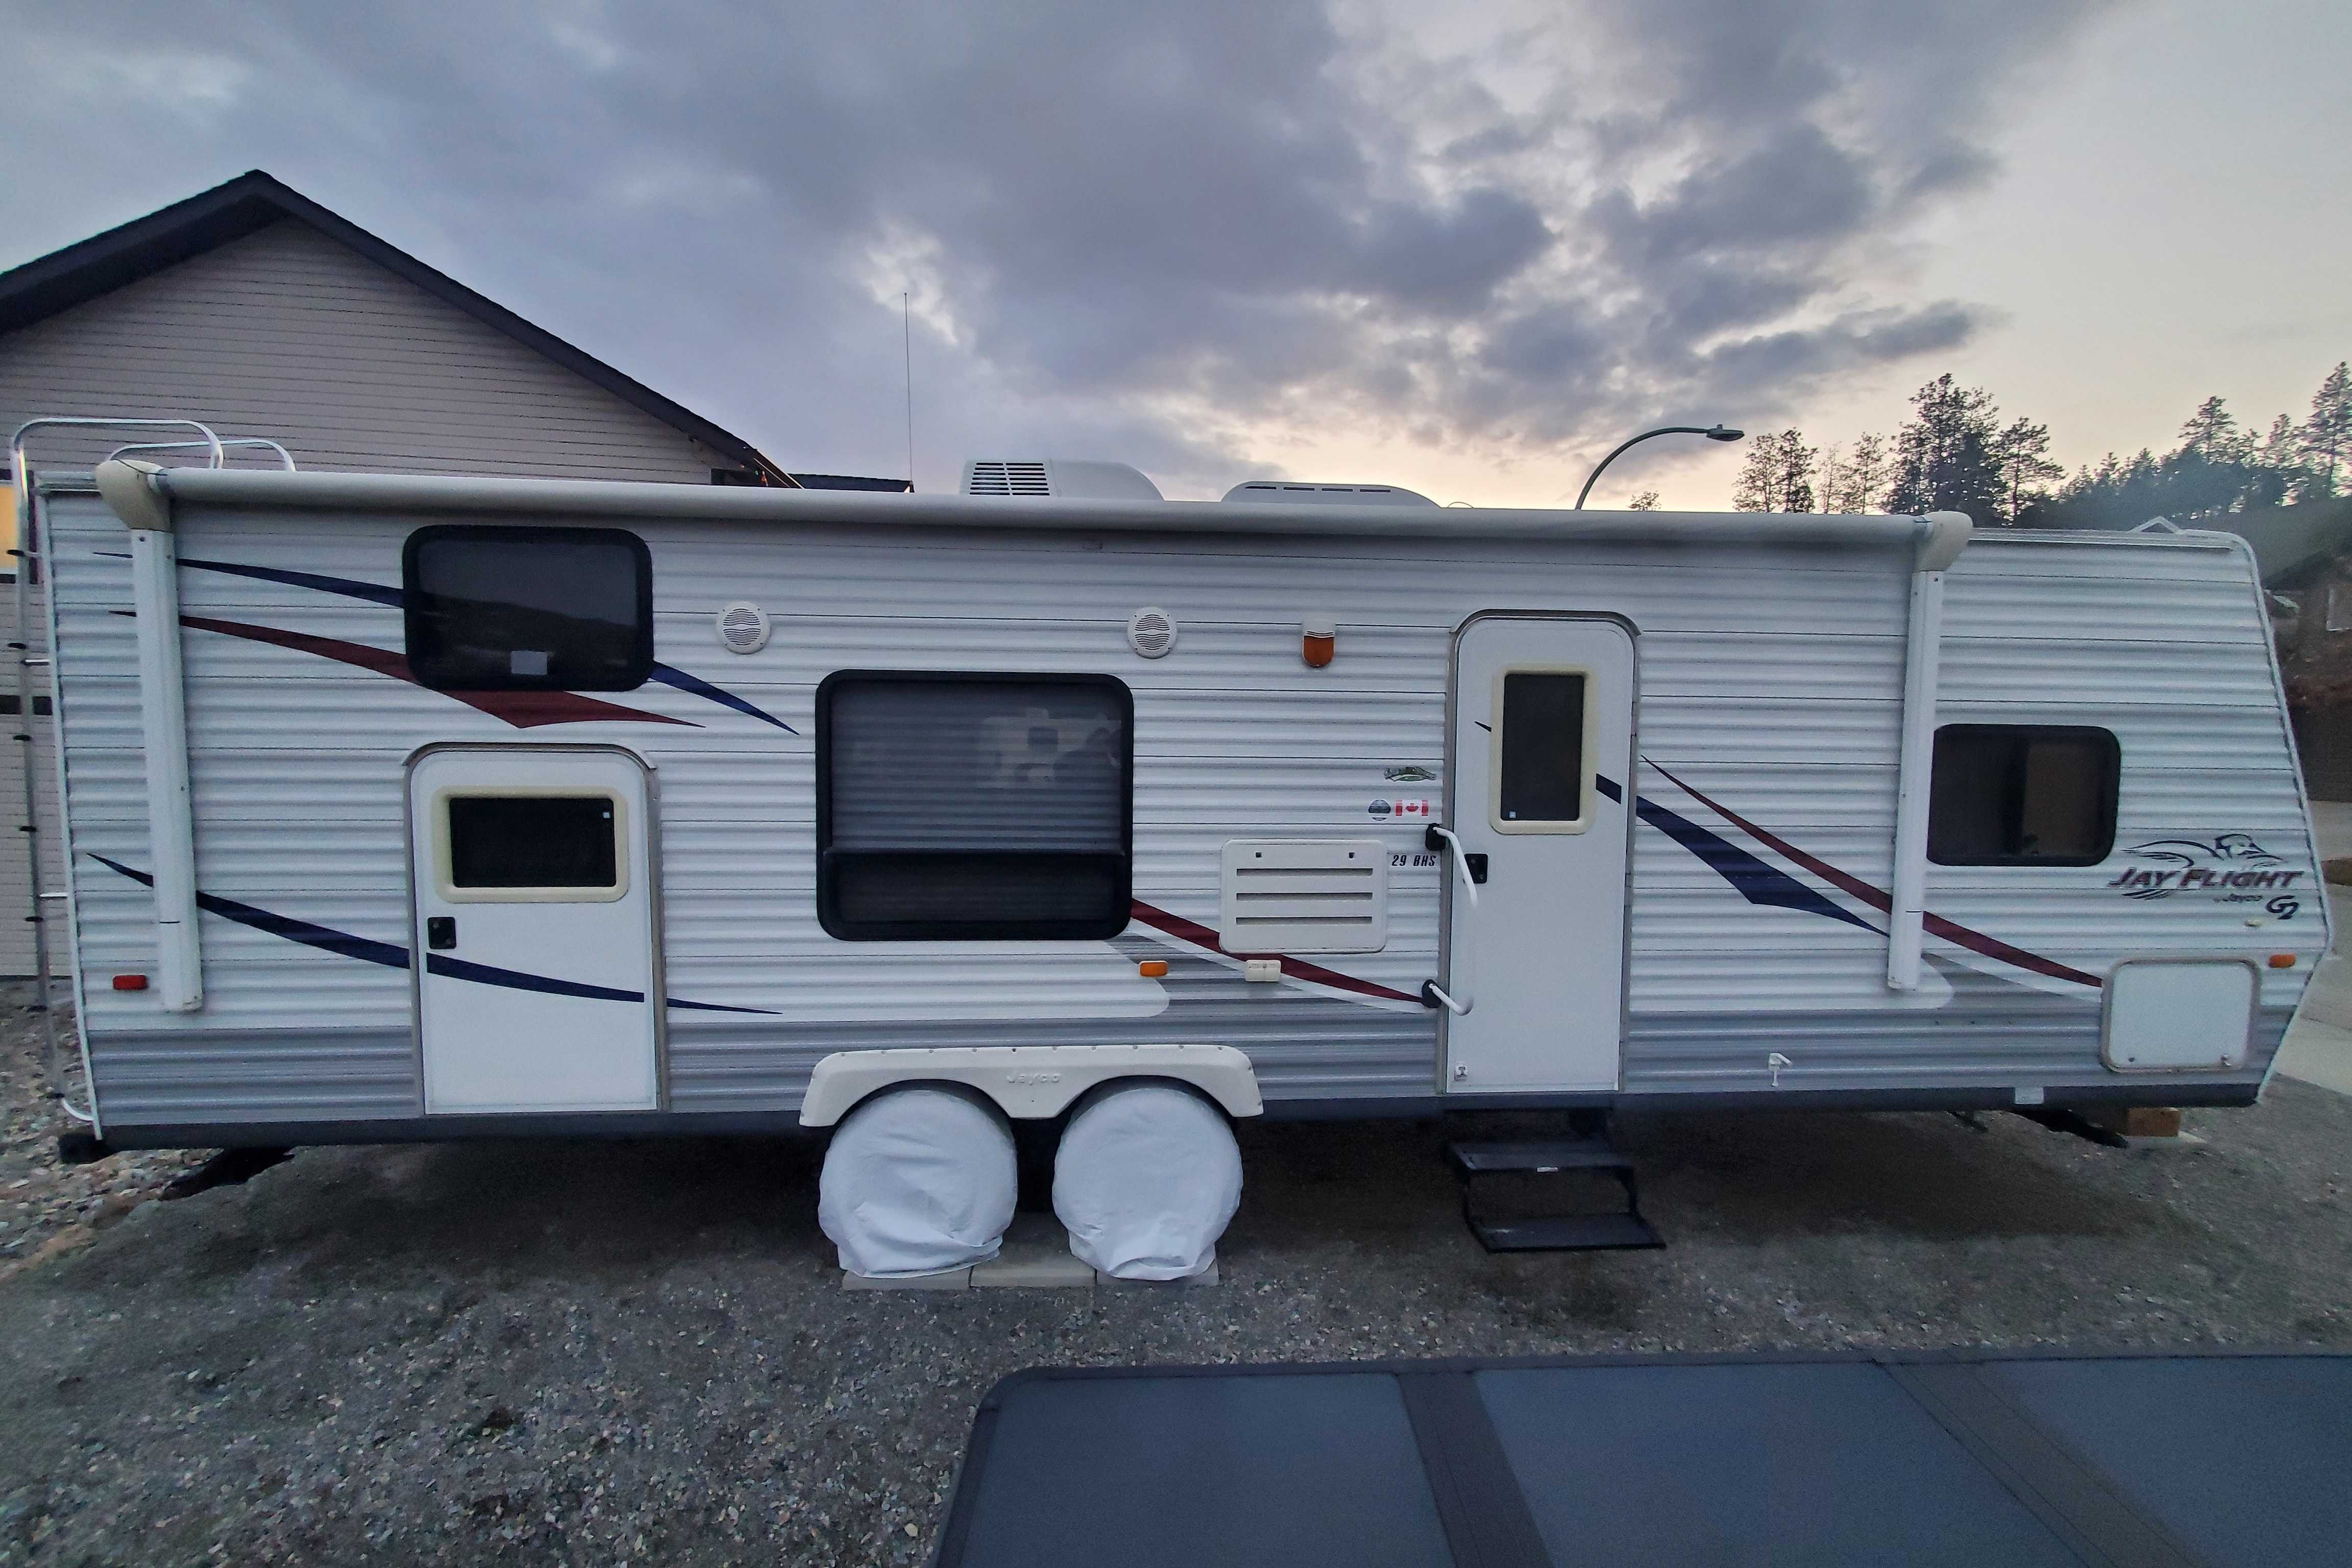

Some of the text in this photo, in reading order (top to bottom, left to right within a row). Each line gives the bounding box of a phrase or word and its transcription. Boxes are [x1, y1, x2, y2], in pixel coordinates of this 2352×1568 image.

[1392, 854, 1436, 867] 29 BHS
[2108, 867, 2304, 888] JAY FLIGHT
[2265, 895, 2299, 920] G2
